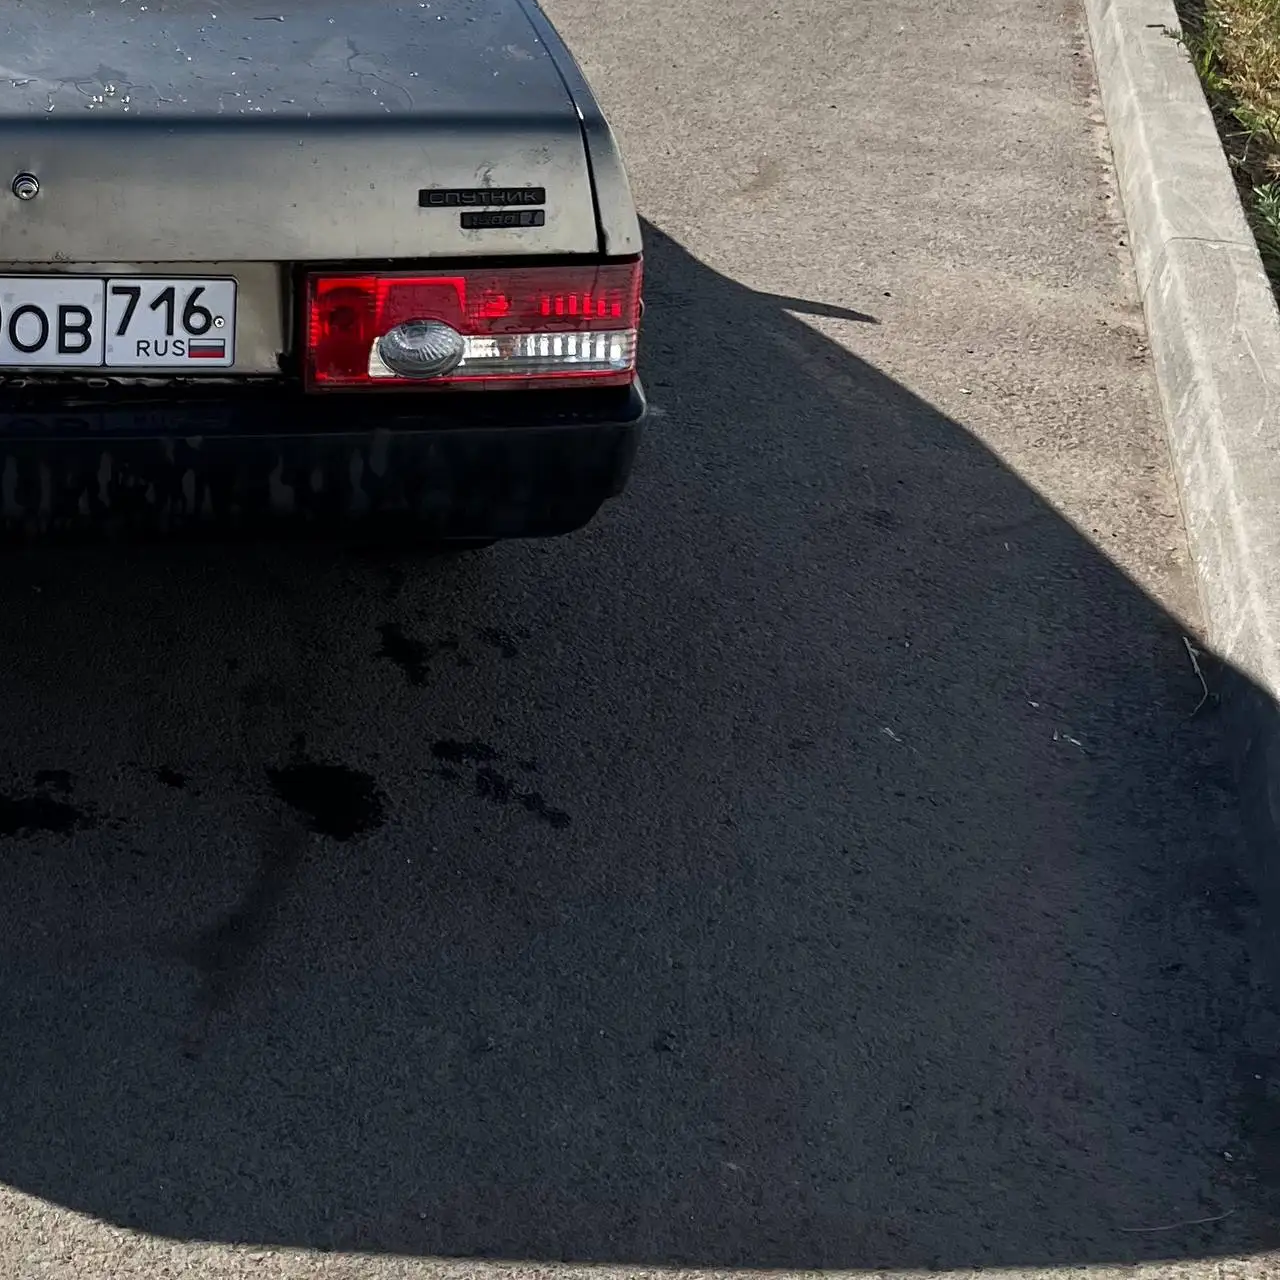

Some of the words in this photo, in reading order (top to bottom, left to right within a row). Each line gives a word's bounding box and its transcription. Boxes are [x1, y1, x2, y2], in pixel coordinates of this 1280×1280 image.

[429, 191, 537, 204] СПУТНИК
[111, 286, 213, 337] 716
[136, 339, 186, 357] RUS
